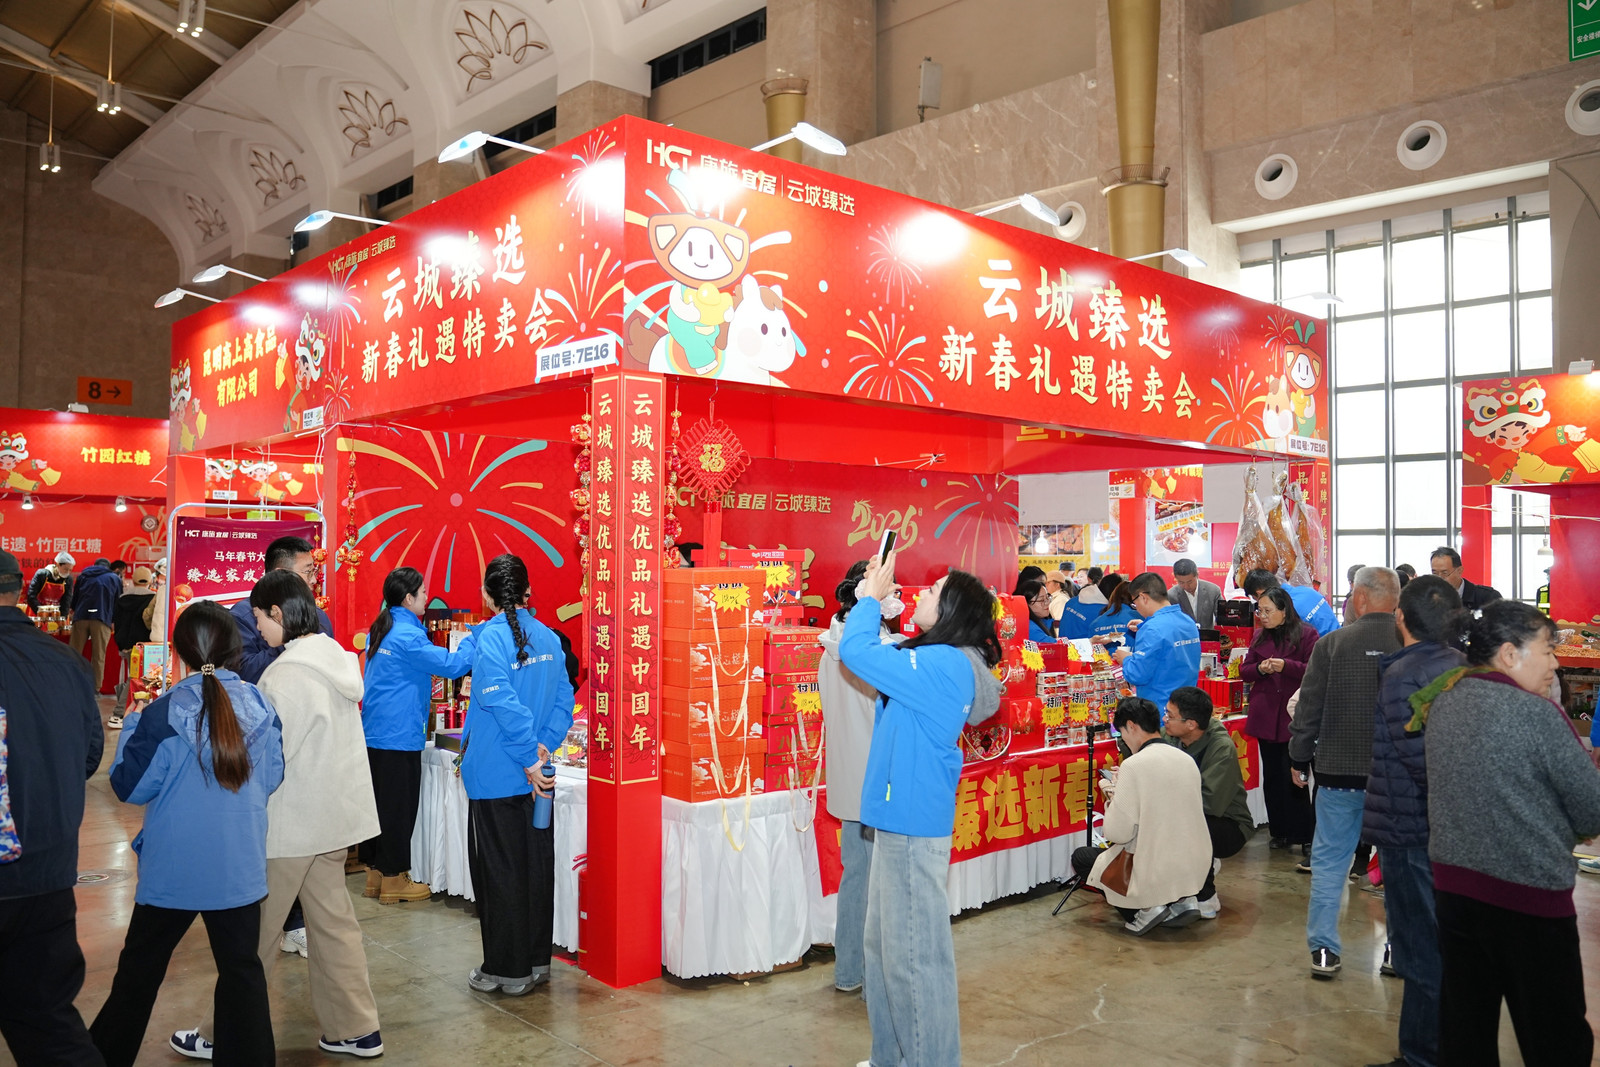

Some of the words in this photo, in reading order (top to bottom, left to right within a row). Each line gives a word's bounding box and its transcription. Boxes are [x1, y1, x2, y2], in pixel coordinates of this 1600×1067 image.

[646, 139, 692, 173] HCT
[786, 179, 855, 216] 云城臻选
[371, 235, 396, 257] 云城臻选
[381, 214, 527, 324] 云城臻选
[977, 258, 1172, 361] 云城臻选
[361, 287, 553, 383] 新春礼遇特卖会
[540, 343, 609, 372] 展位号:7E16
[216, 367, 258, 407] 有限公司
[939, 326, 1197, 420] 新春礼遇特卖会
[88, 381, 101, 400] 8
[80, 447, 152, 466] 竹园红糖
[699, 443, 726, 473] 福
[775, 494, 832, 514] 云城臻选
[186, 568, 266, 583] 臻选家政
[594, 393, 613, 751] 云城臻选优品礼遇中国年
[629, 393, 655, 751] 云城臻选优品礼遇中国年
[1047, 696, 1062, 708] 特价
[1071, 692, 1087, 703] 特价
